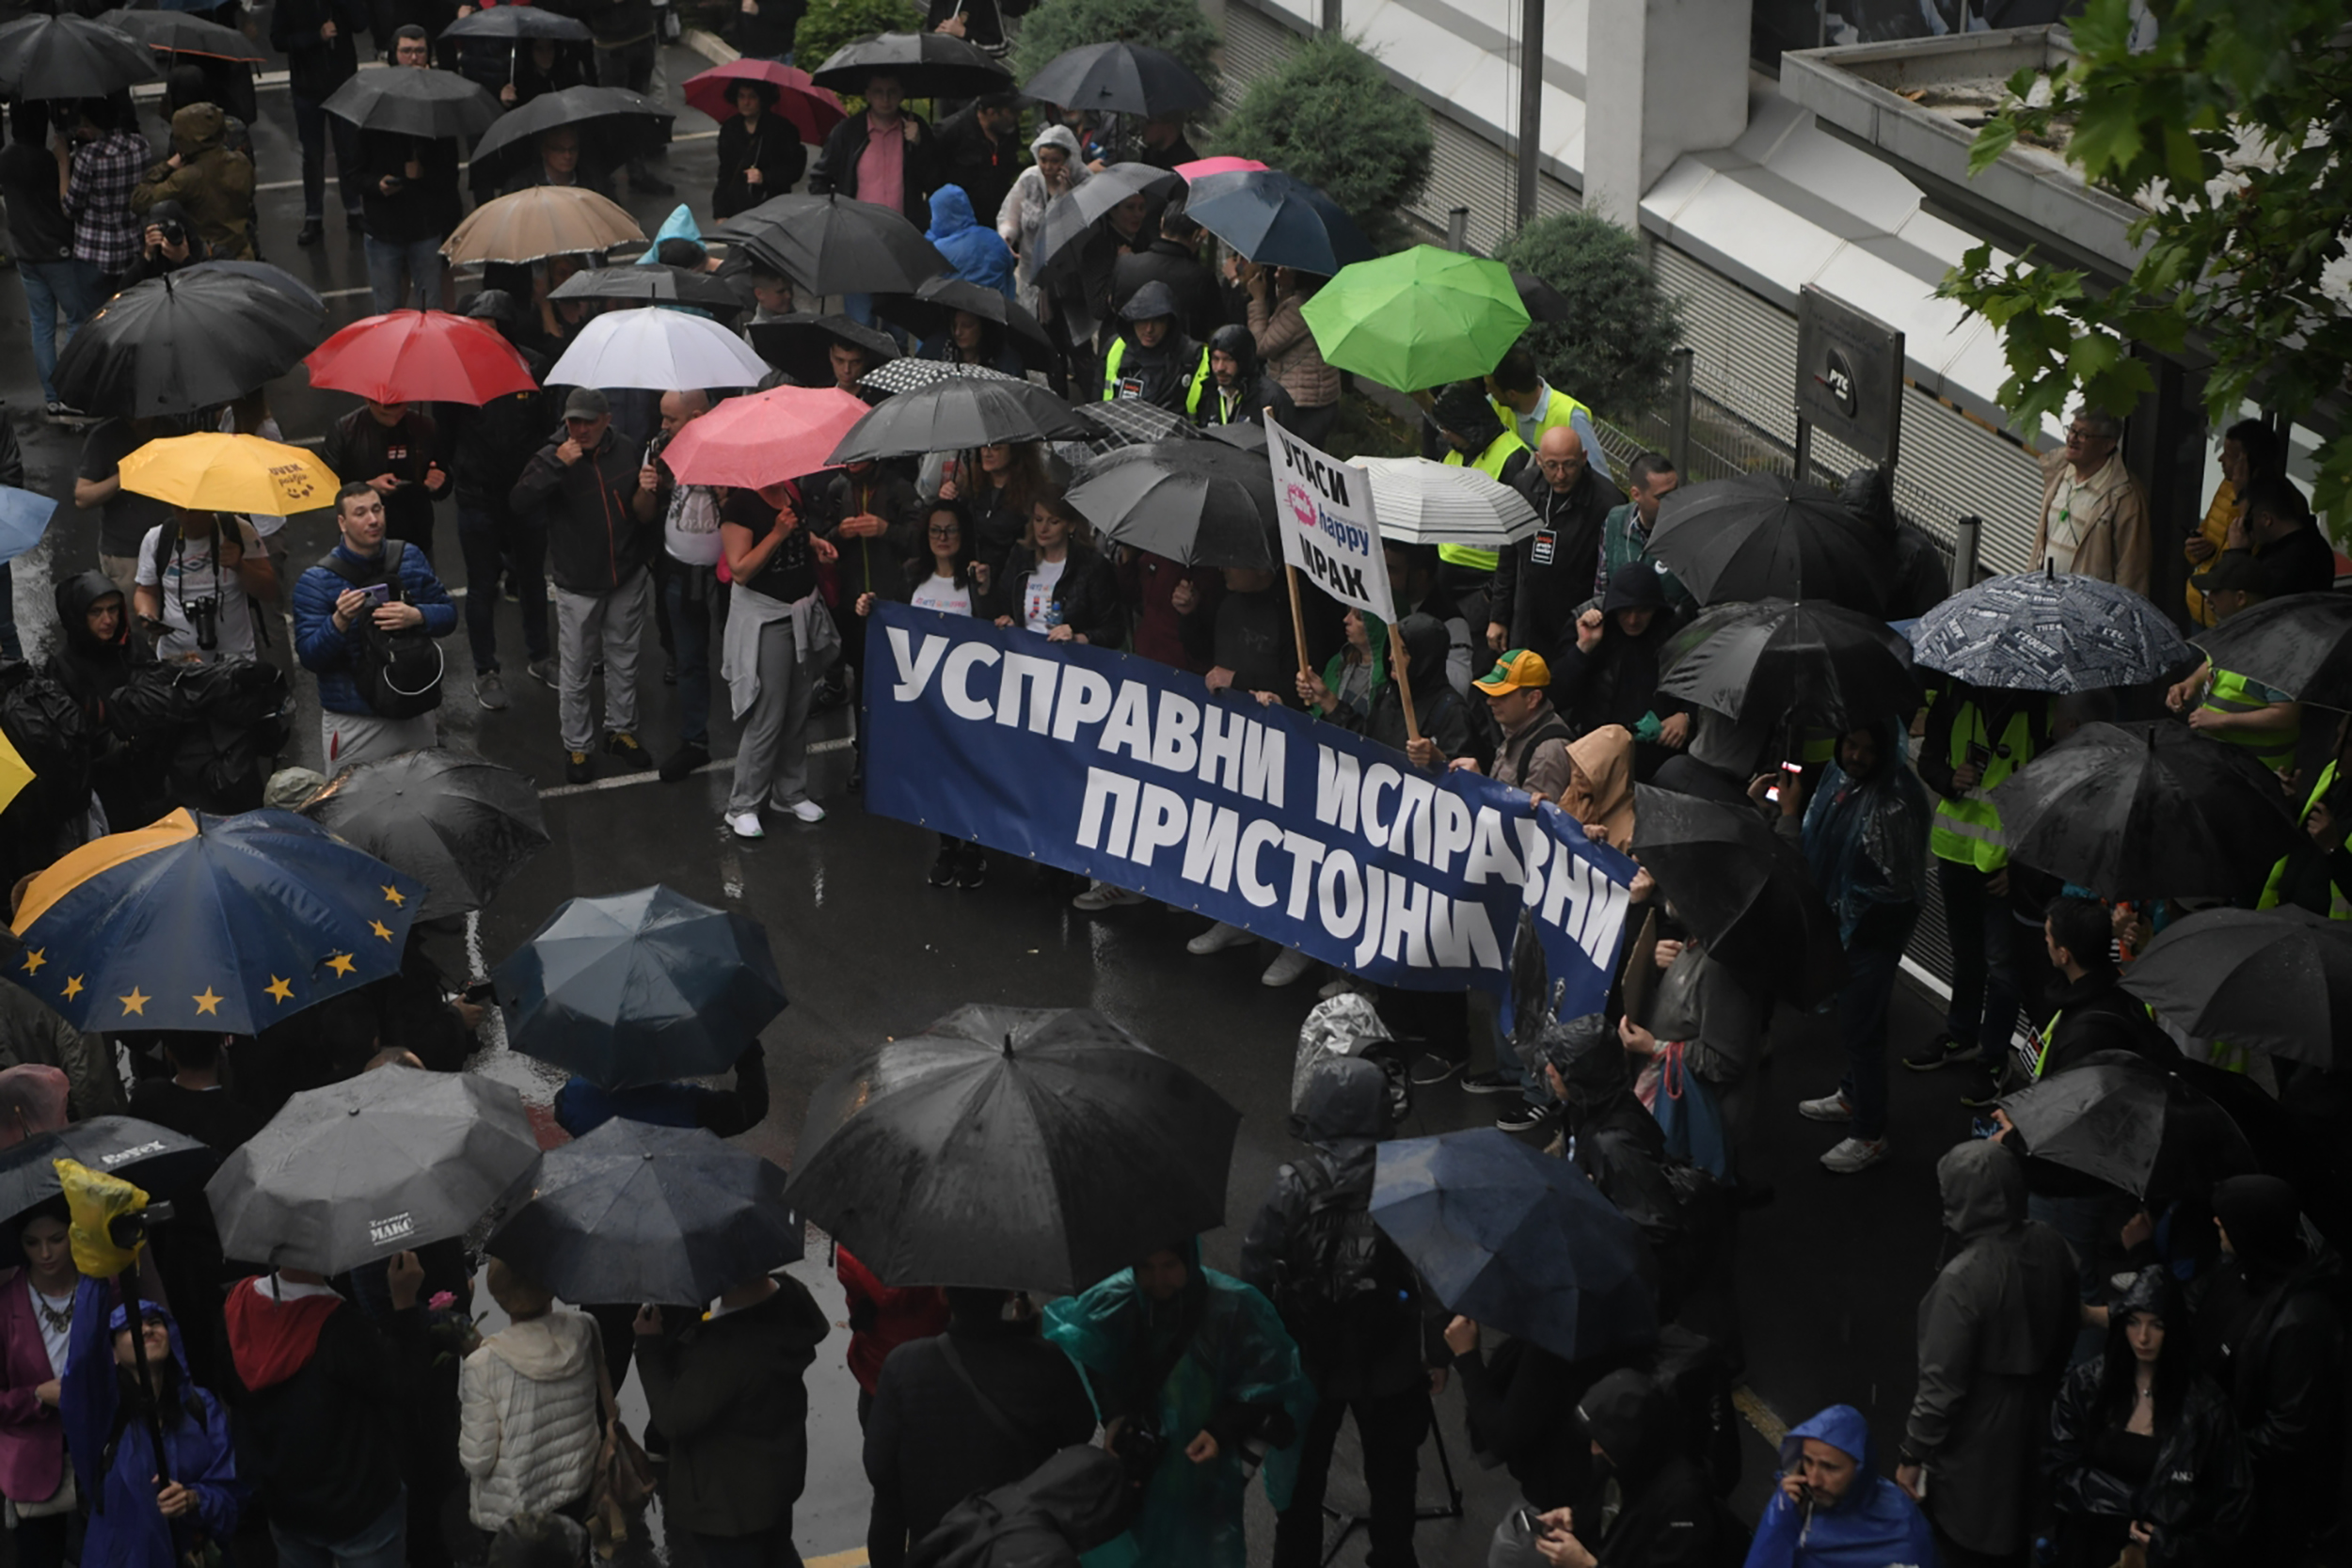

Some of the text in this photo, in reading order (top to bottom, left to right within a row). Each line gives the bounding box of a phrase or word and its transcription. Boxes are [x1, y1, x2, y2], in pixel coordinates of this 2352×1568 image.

[1279, 432, 1350, 507] УГАСИ
[1318, 502, 1369, 556] happy
[1298, 532, 1371, 602] МРАК
[885, 626, 1631, 972] УСПРАВНИ ИСПРАВНИ
[1075, 766, 1503, 972] ПРИСТОЈНИ
